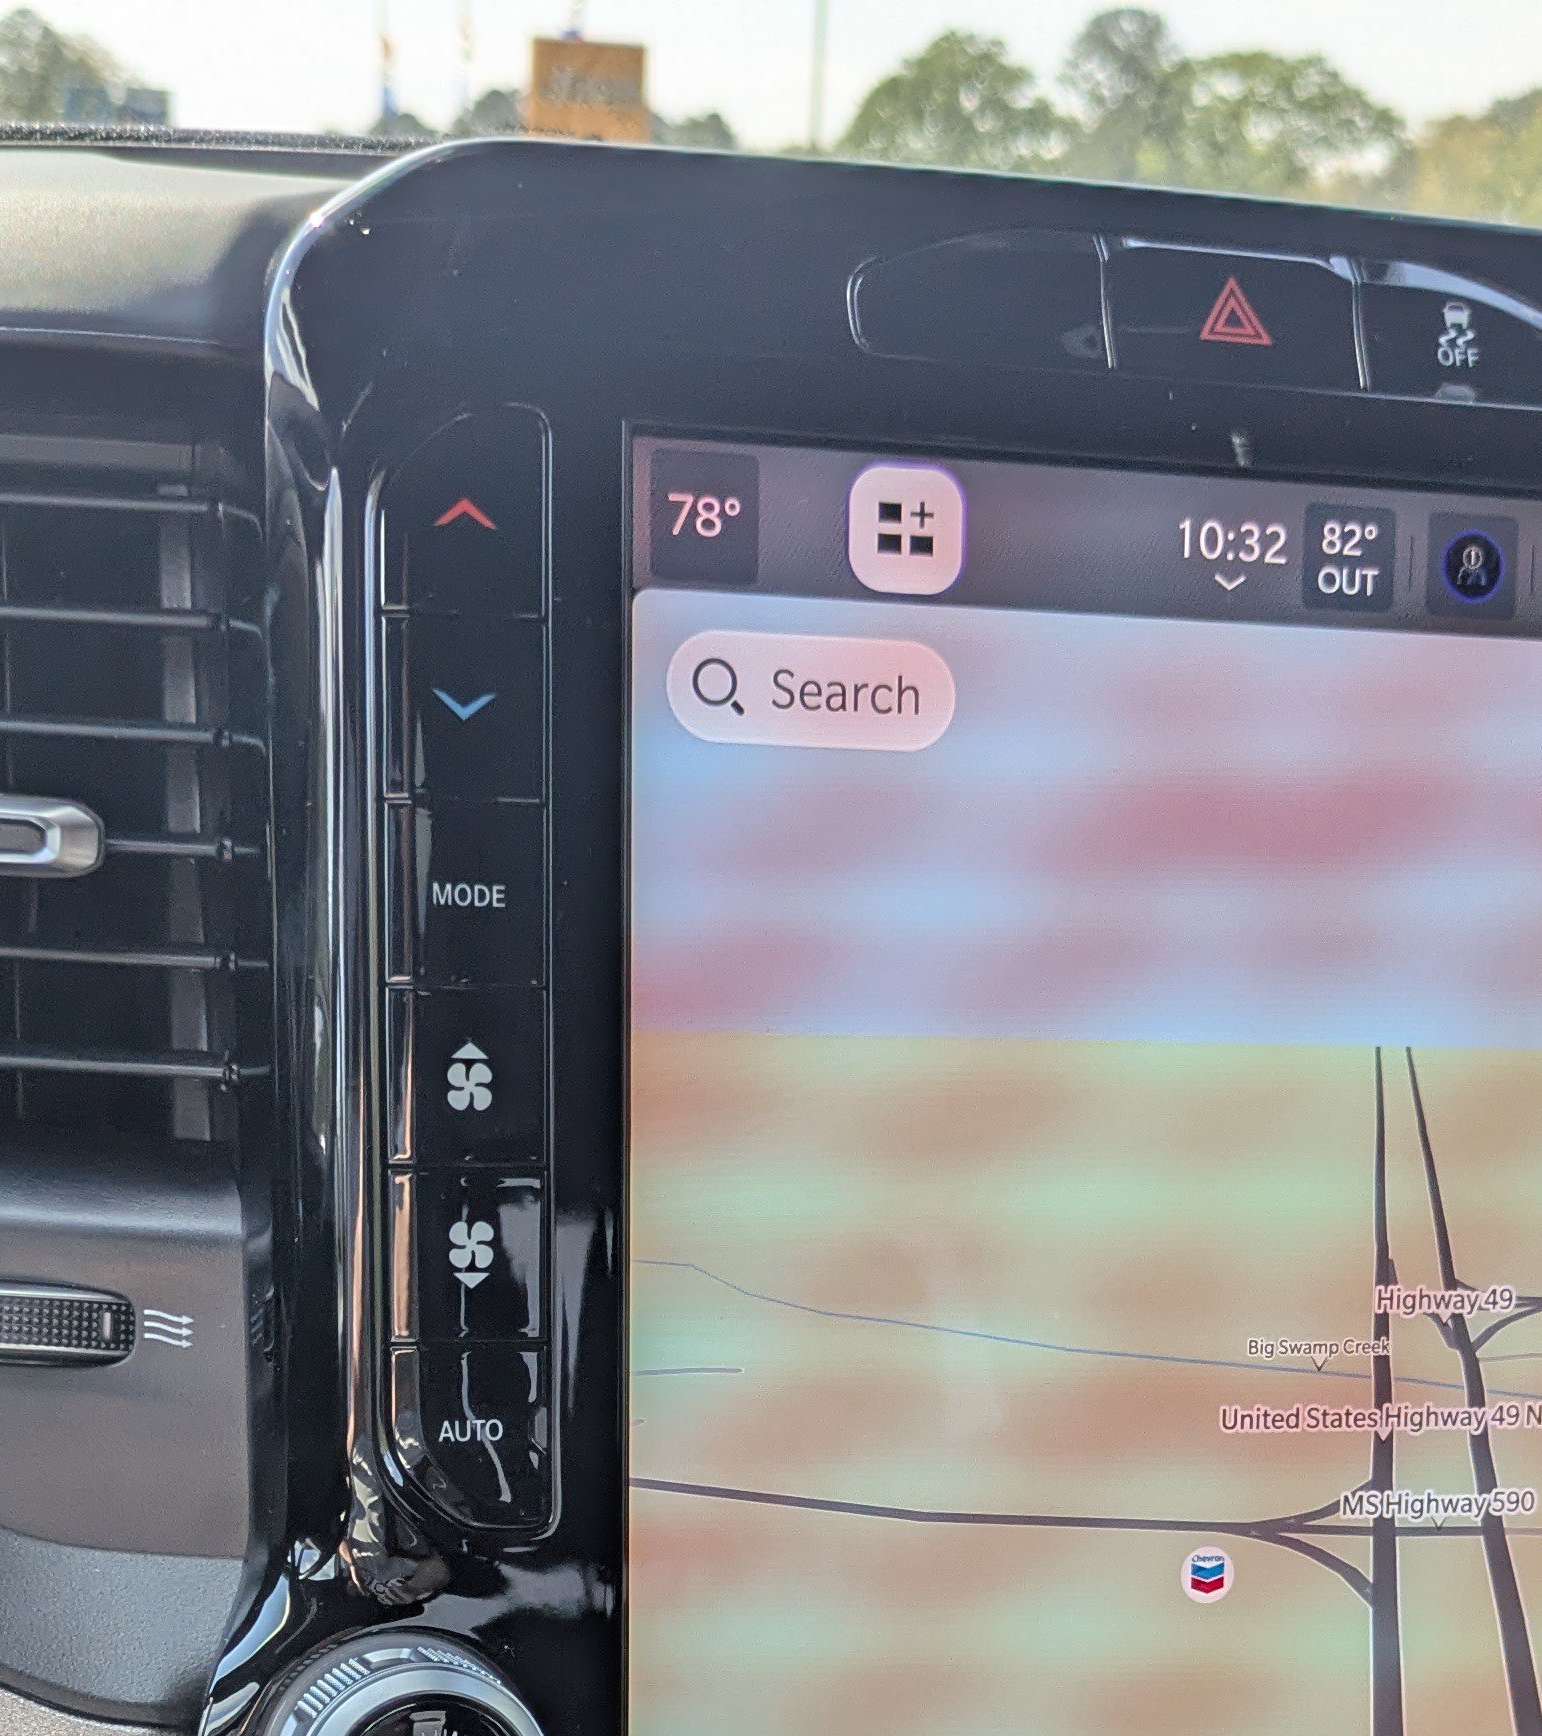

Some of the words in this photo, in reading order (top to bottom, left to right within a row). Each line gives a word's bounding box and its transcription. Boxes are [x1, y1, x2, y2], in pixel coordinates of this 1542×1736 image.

[1438, 347, 1479, 367] OFF
[1178, 517, 1288, 565] 10:32
[1317, 567, 1380, 597] OUT
[771, 668, 920, 716] Search
[432, 883, 506, 908] MODE
[1376, 1288, 1479, 1314] Highway
[1483, 1288, 1514, 1310] 49
[1248, 1339, 1274, 1356] Big
[1278, 1339, 1339, 1356] Swamp
[1343, 1339, 1390, 1355] Creek
[438, 1419, 503, 1442] AUTO
[1221, 1408, 1300, 1429] United
[1306, 1407, 1378, 1428] States
[1385, 1405, 1487, 1433] Highway
[1490, 1405, 1520, 1426] 49
[1526, 1404, 1542, 1425] N
[1342, 1493, 1379, 1516] MS
[1385, 1491, 1488, 1520] Highway
[1491, 1490, 1535, 1512] 590
